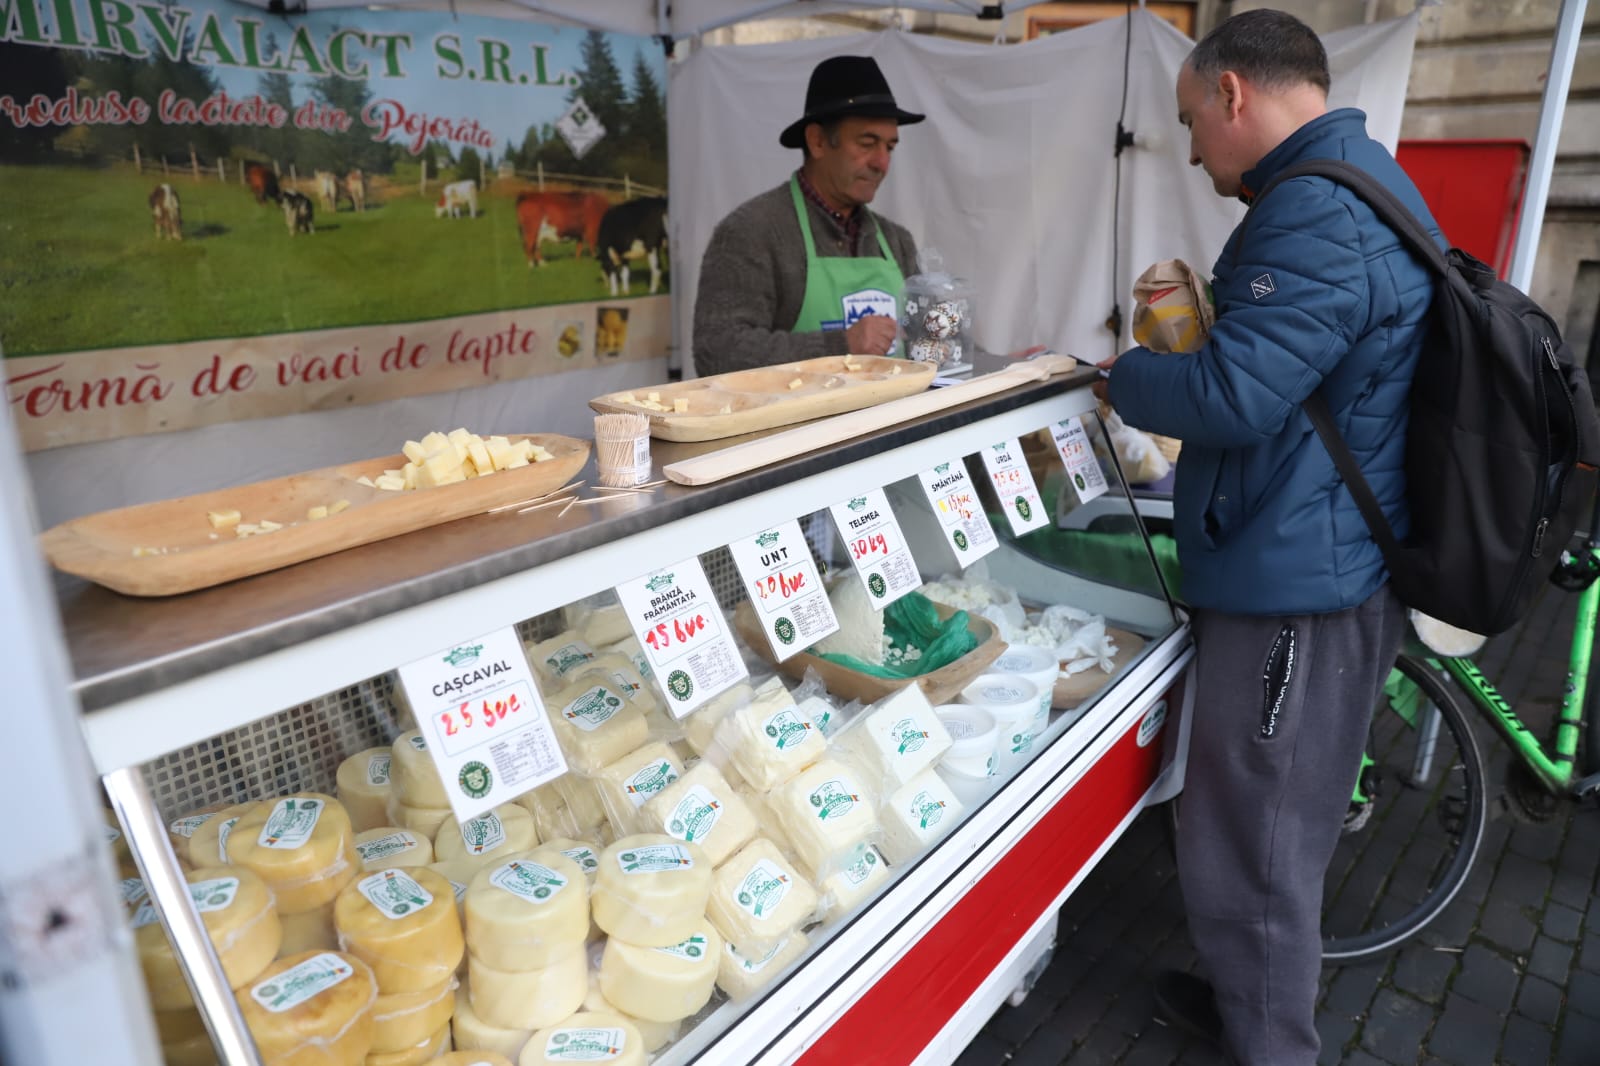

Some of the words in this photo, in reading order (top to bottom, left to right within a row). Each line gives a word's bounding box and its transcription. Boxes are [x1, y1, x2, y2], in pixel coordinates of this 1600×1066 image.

[434, 34, 581, 86] S.R.L.
[0, 86, 150, 128] roduse
[159, 88, 288, 127] lactate
[293, 99, 352, 133] din
[191, 354, 257, 398] de
[277, 346, 360, 387] vaci
[379, 335, 427, 373] de
[446, 321, 537, 377] lapte
[848, 510, 880, 530] TELEMEA
[760, 547, 789, 567] UNT
[432, 660, 512, 698] CAȘCAVAL
